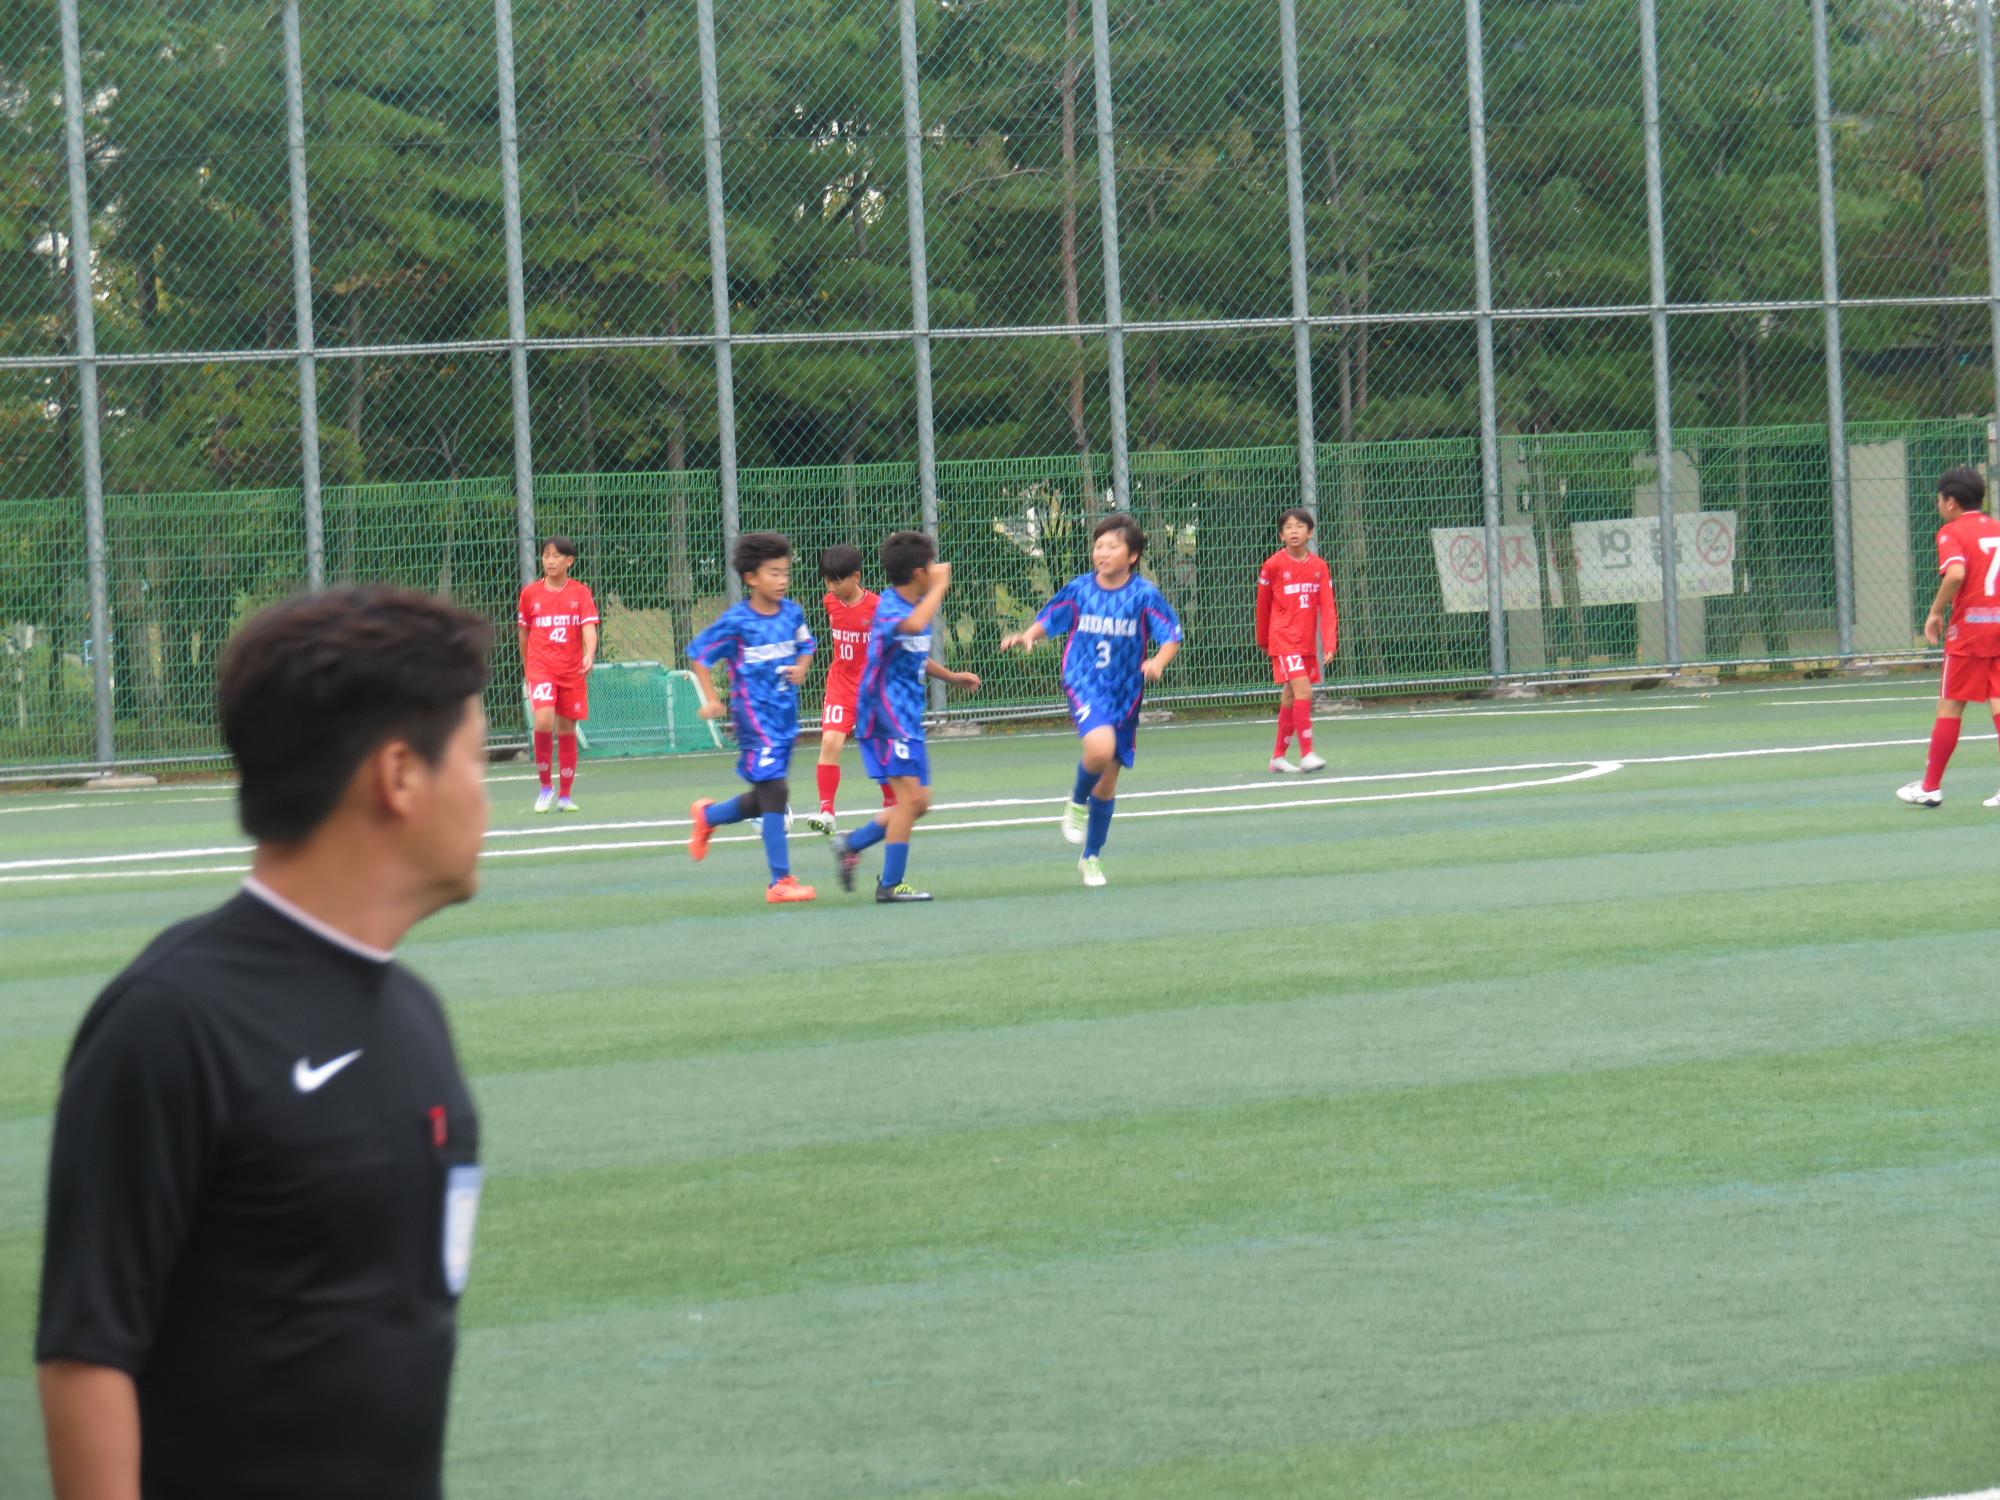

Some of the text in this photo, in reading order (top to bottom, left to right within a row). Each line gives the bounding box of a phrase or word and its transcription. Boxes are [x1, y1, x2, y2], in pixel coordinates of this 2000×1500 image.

[549, 627, 568, 643] 42
[843, 630, 860, 643] CITY
[840, 643, 854, 661] 10
[1095, 640, 1112, 668] 3
[1286, 654, 1305, 672] 12
[532, 682, 554, 701] 42
[824, 704, 843, 723] 10
